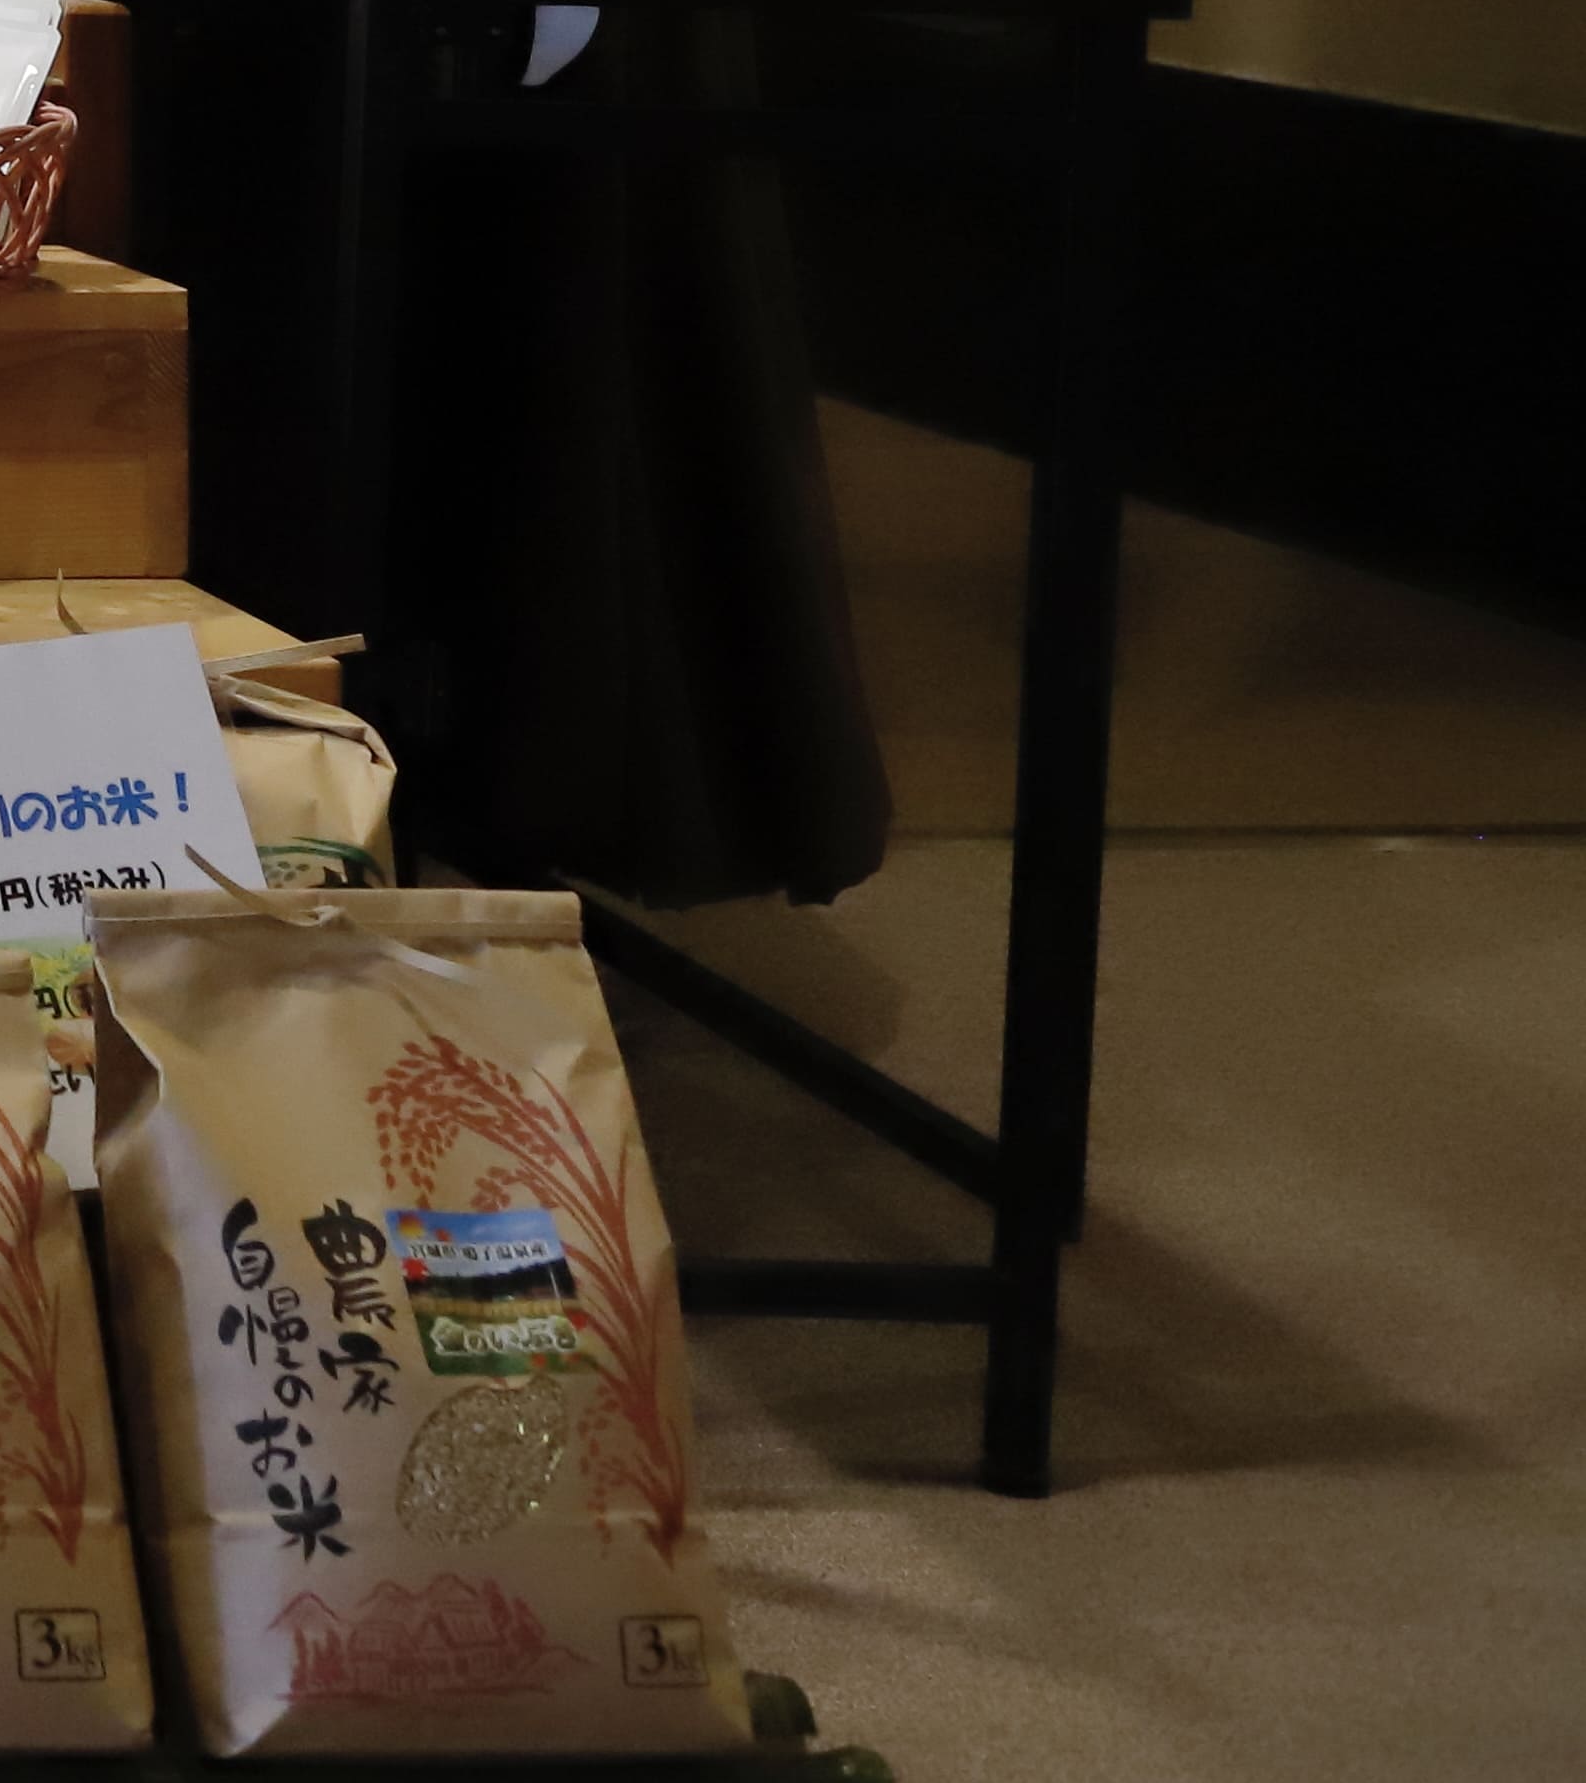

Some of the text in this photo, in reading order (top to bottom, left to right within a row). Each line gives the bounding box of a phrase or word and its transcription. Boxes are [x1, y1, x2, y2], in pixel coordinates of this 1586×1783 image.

[302, 1199, 401, 1417] 農家
[432, 1319, 580, 1356] 金のいぶき
[218, 1197, 354, 1564] 自慢のお米
[34, 1618, 96, 1671] 3kg
[641, 1625, 703, 1680] 3kg
